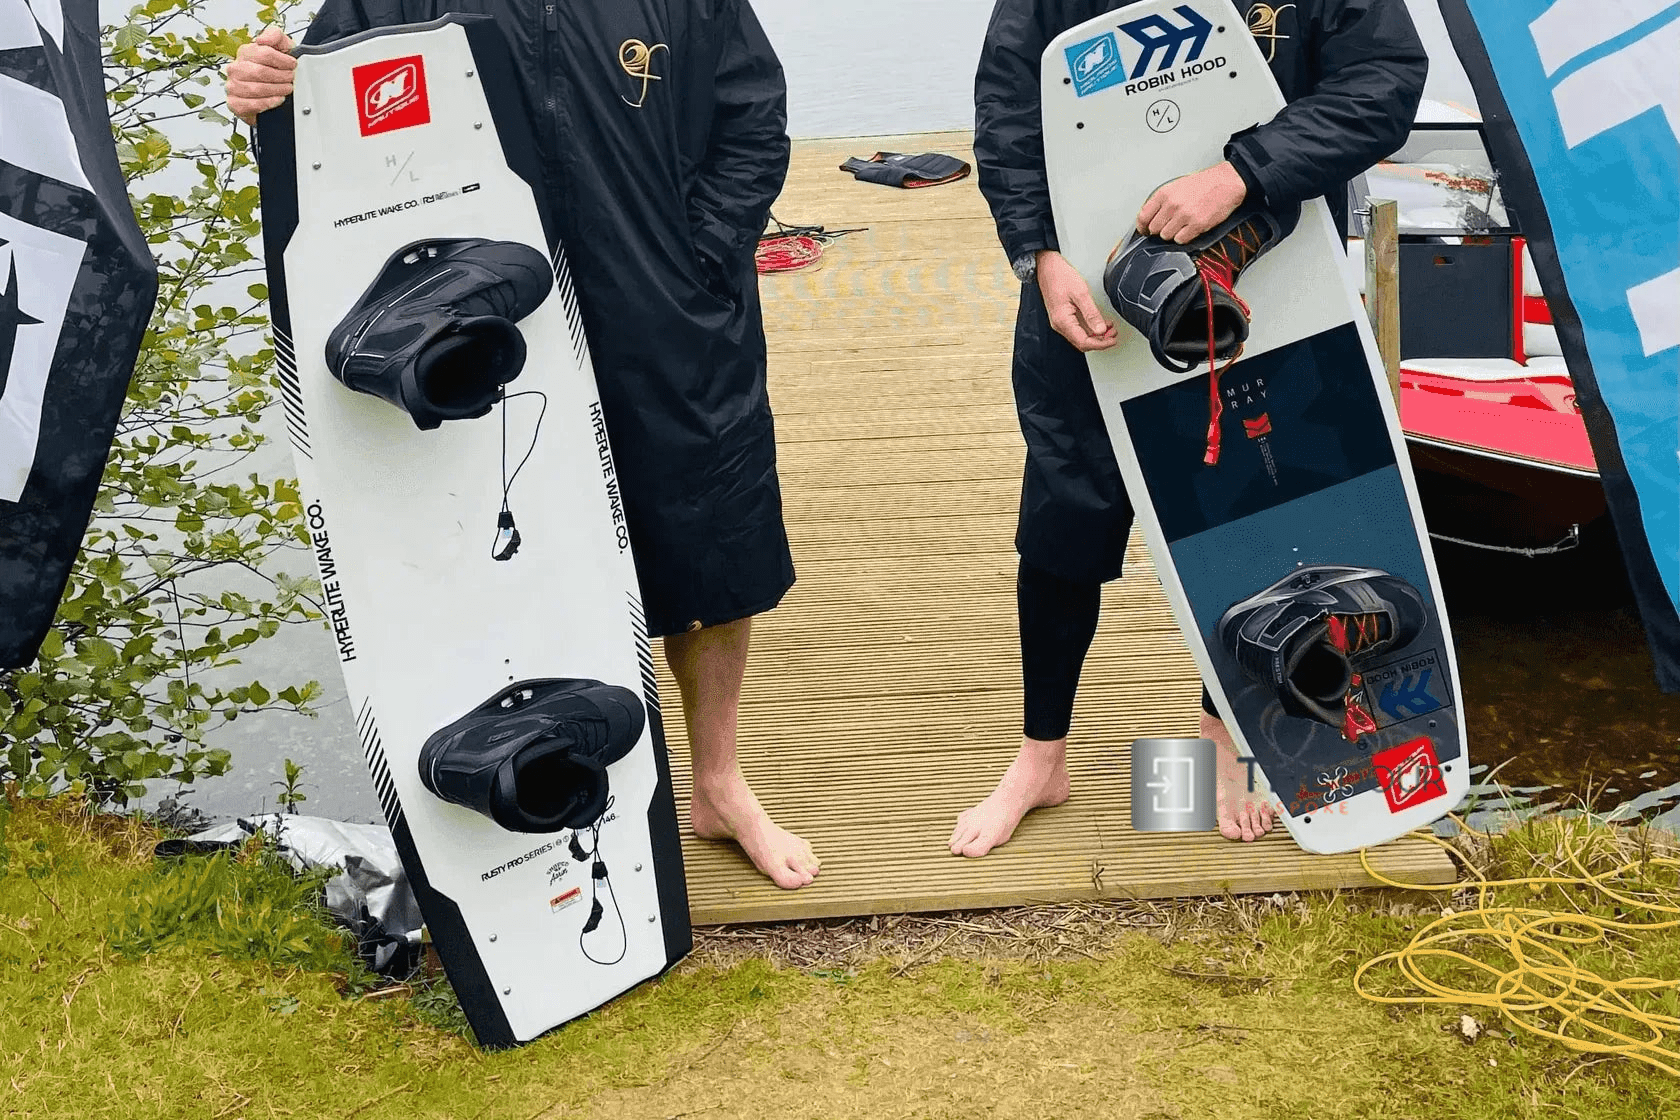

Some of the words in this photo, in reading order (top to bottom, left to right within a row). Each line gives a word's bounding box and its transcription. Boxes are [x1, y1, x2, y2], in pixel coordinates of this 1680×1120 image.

[1125, 71, 1176, 96] ROBIN
[1180, 56, 1227, 79] HOOD
[333, 211, 377, 229] HYPERLITE
[378, 203, 403, 217] WAKE
[403, 199, 420, 211] CO.
[589, 401, 615, 479] HYPERLITE
[606, 478, 624, 526] WAKE
[615, 525, 629, 554] CO.
[307, 499, 325, 530] CO.
[312, 530, 337, 580] WAKE
[324, 581, 357, 662] HYPERLITE
[1366, 670, 1398, 685] HOOD
[1400, 656, 1435, 674] ROBIN
[481, 863, 507, 881] RUSTY
[507, 857, 524, 870] PRO
[524, 842, 553, 862] SERIES
